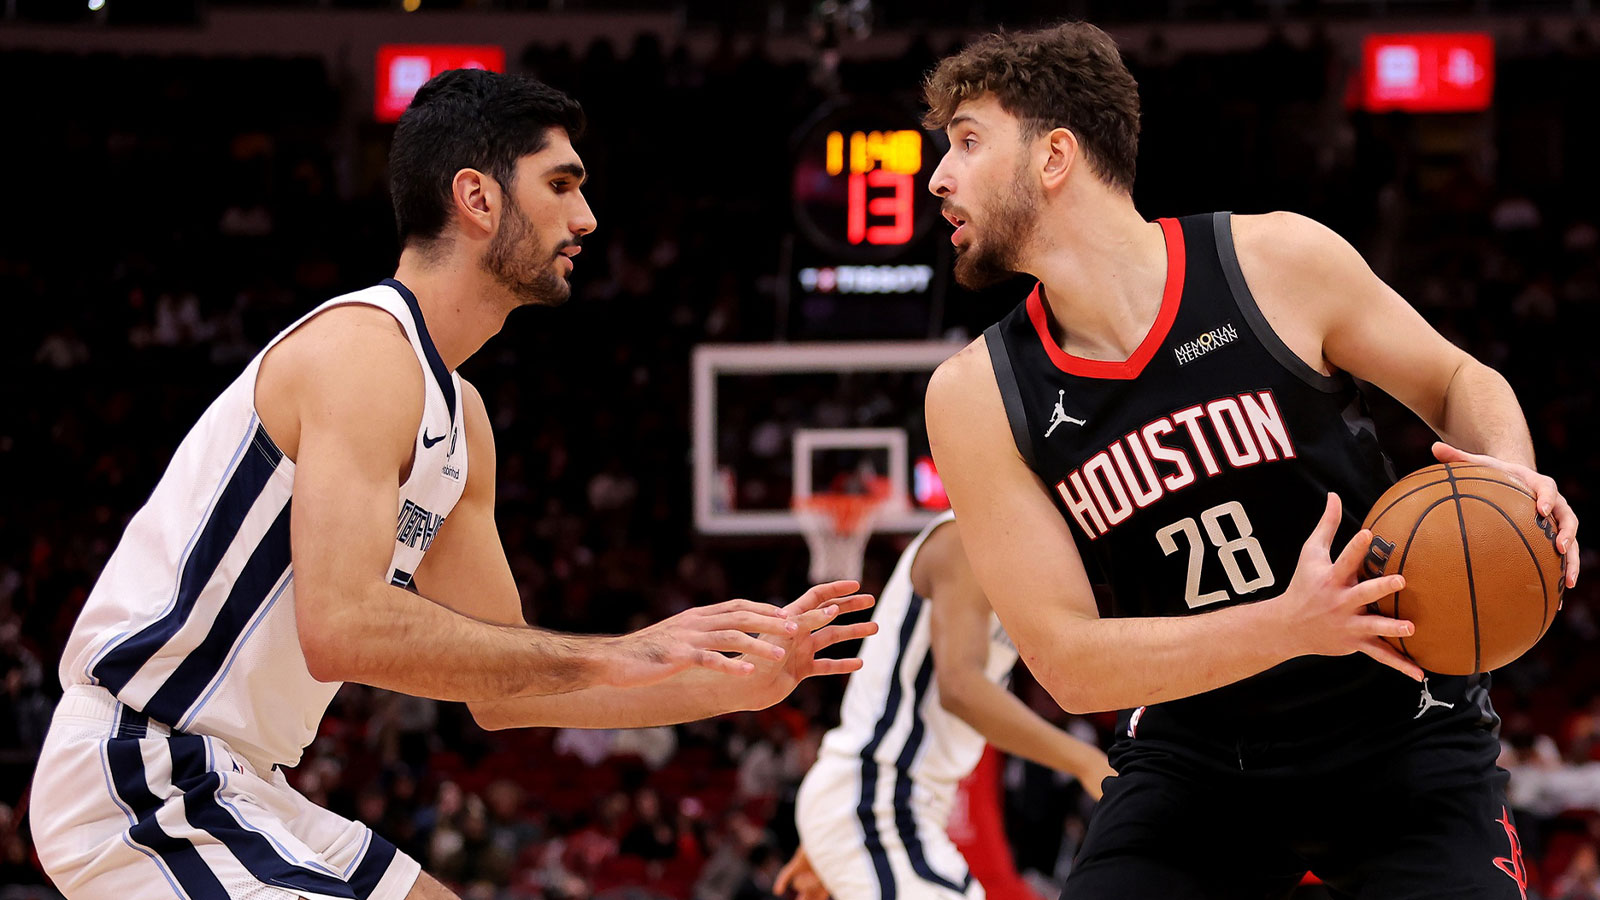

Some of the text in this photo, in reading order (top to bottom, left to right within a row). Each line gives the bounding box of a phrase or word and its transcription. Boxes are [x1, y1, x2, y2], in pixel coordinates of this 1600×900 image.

[848, 169, 914, 245] 13
[1174, 323, 1237, 356] MEMORIAL
[1176, 328, 1239, 365] HERMANN
[1054, 389, 1297, 541] HOUSTON
[1155, 501, 1275, 609] 28
